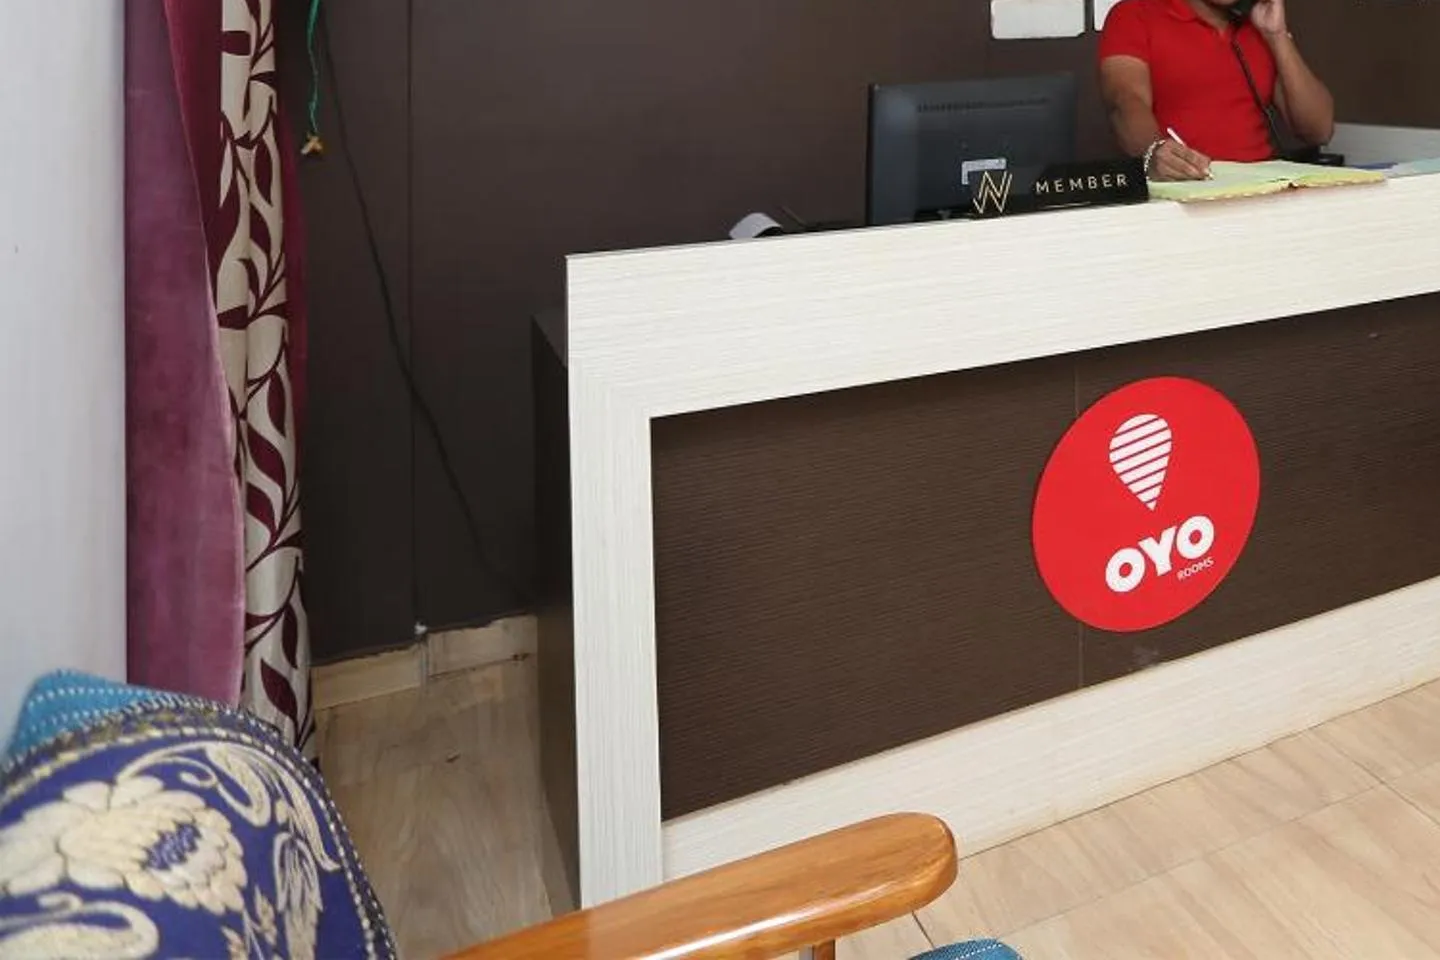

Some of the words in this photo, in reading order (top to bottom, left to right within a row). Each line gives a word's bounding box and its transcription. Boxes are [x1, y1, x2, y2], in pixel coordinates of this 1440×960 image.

[1035, 173, 1129, 195] MEMBER
[1105, 515, 1215, 592] OYO
[1177, 556, 1214, 581] ROOMS
